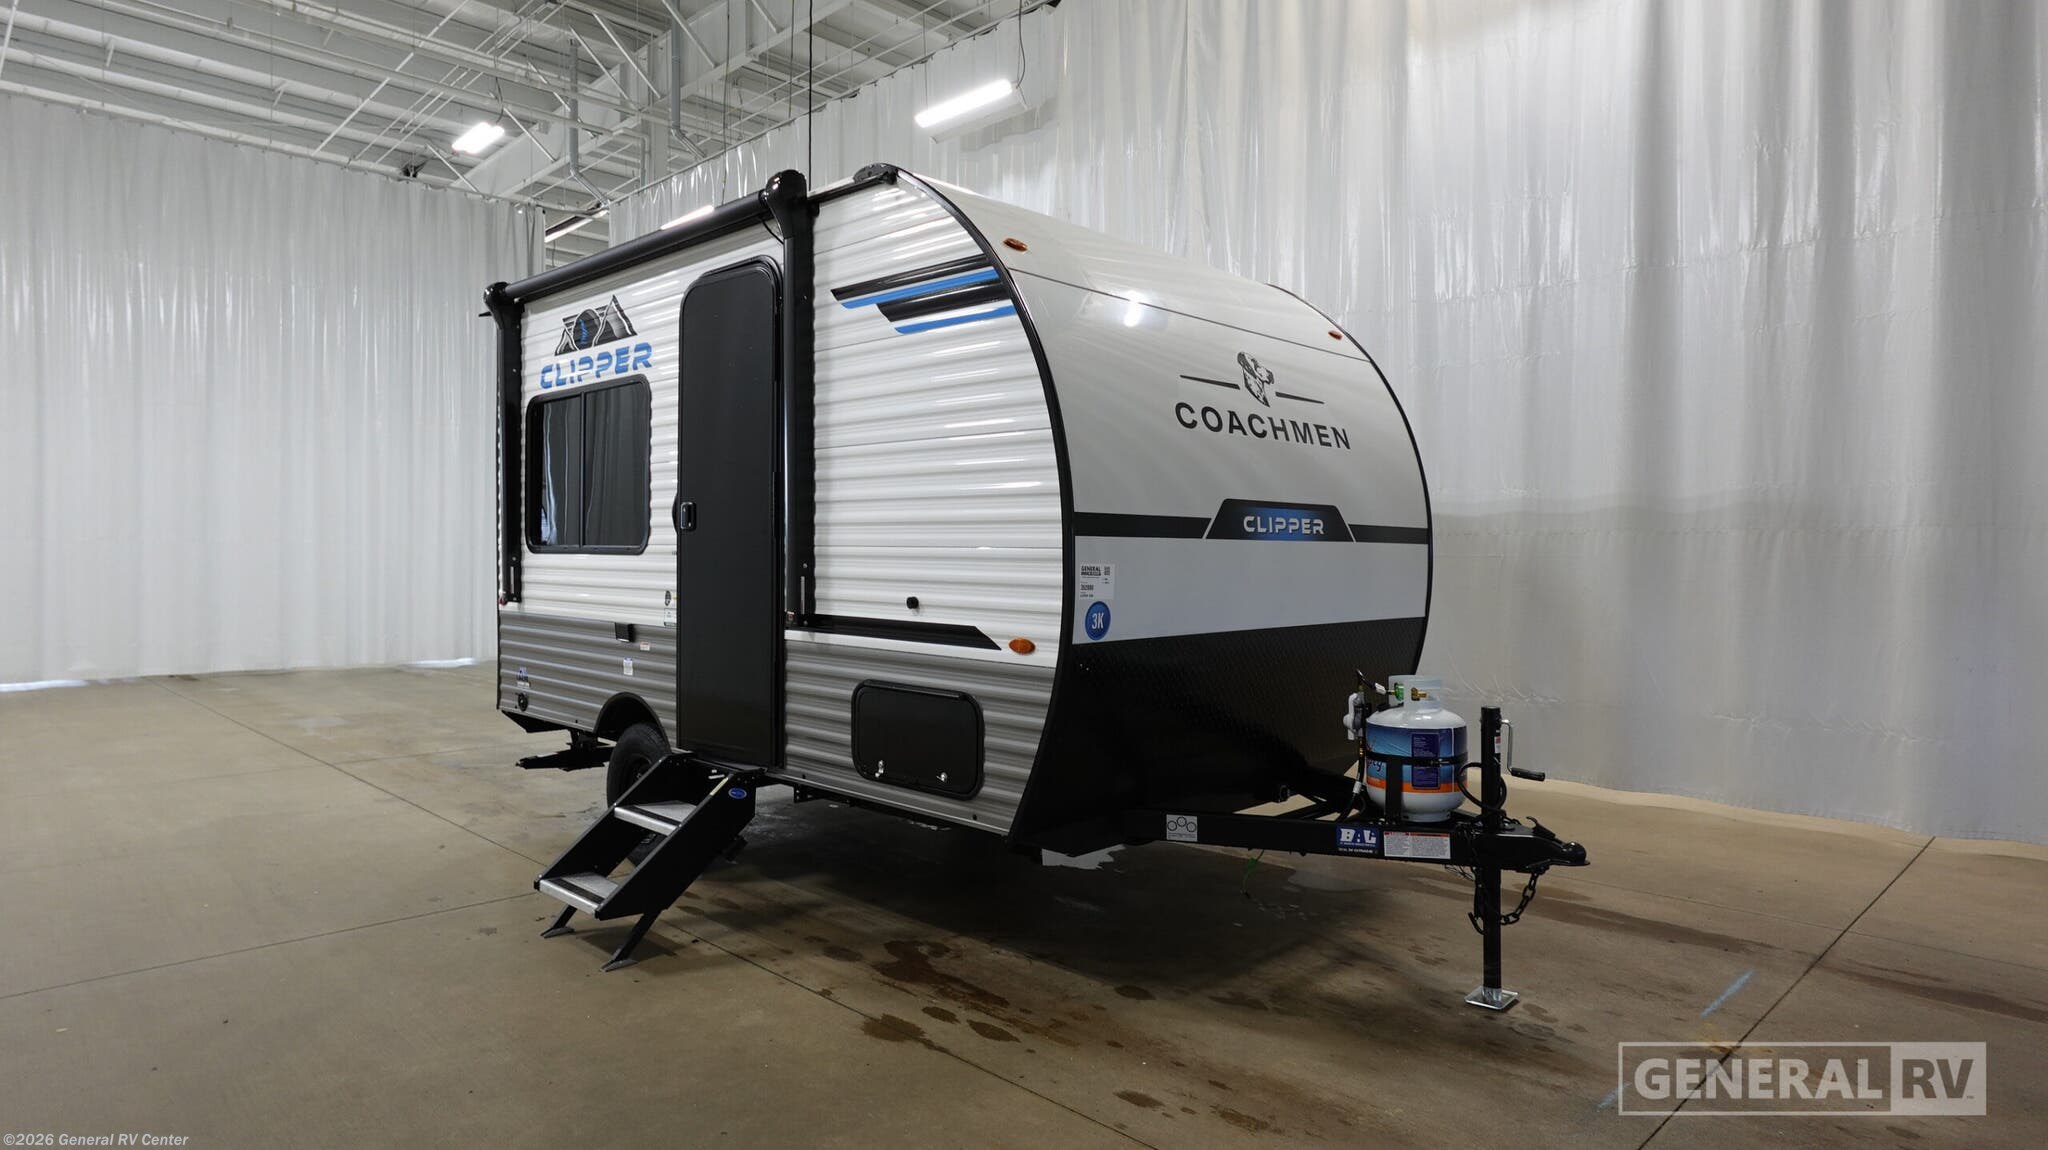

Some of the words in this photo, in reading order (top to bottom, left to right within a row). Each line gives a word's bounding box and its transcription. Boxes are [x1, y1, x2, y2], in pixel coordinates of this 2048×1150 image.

[540, 342, 653, 389] CLIPPER
[1175, 402, 1351, 450] COACHMEN
[1243, 515, 1325, 535] CLIPPER
[1091, 612, 1104, 630] 3K
